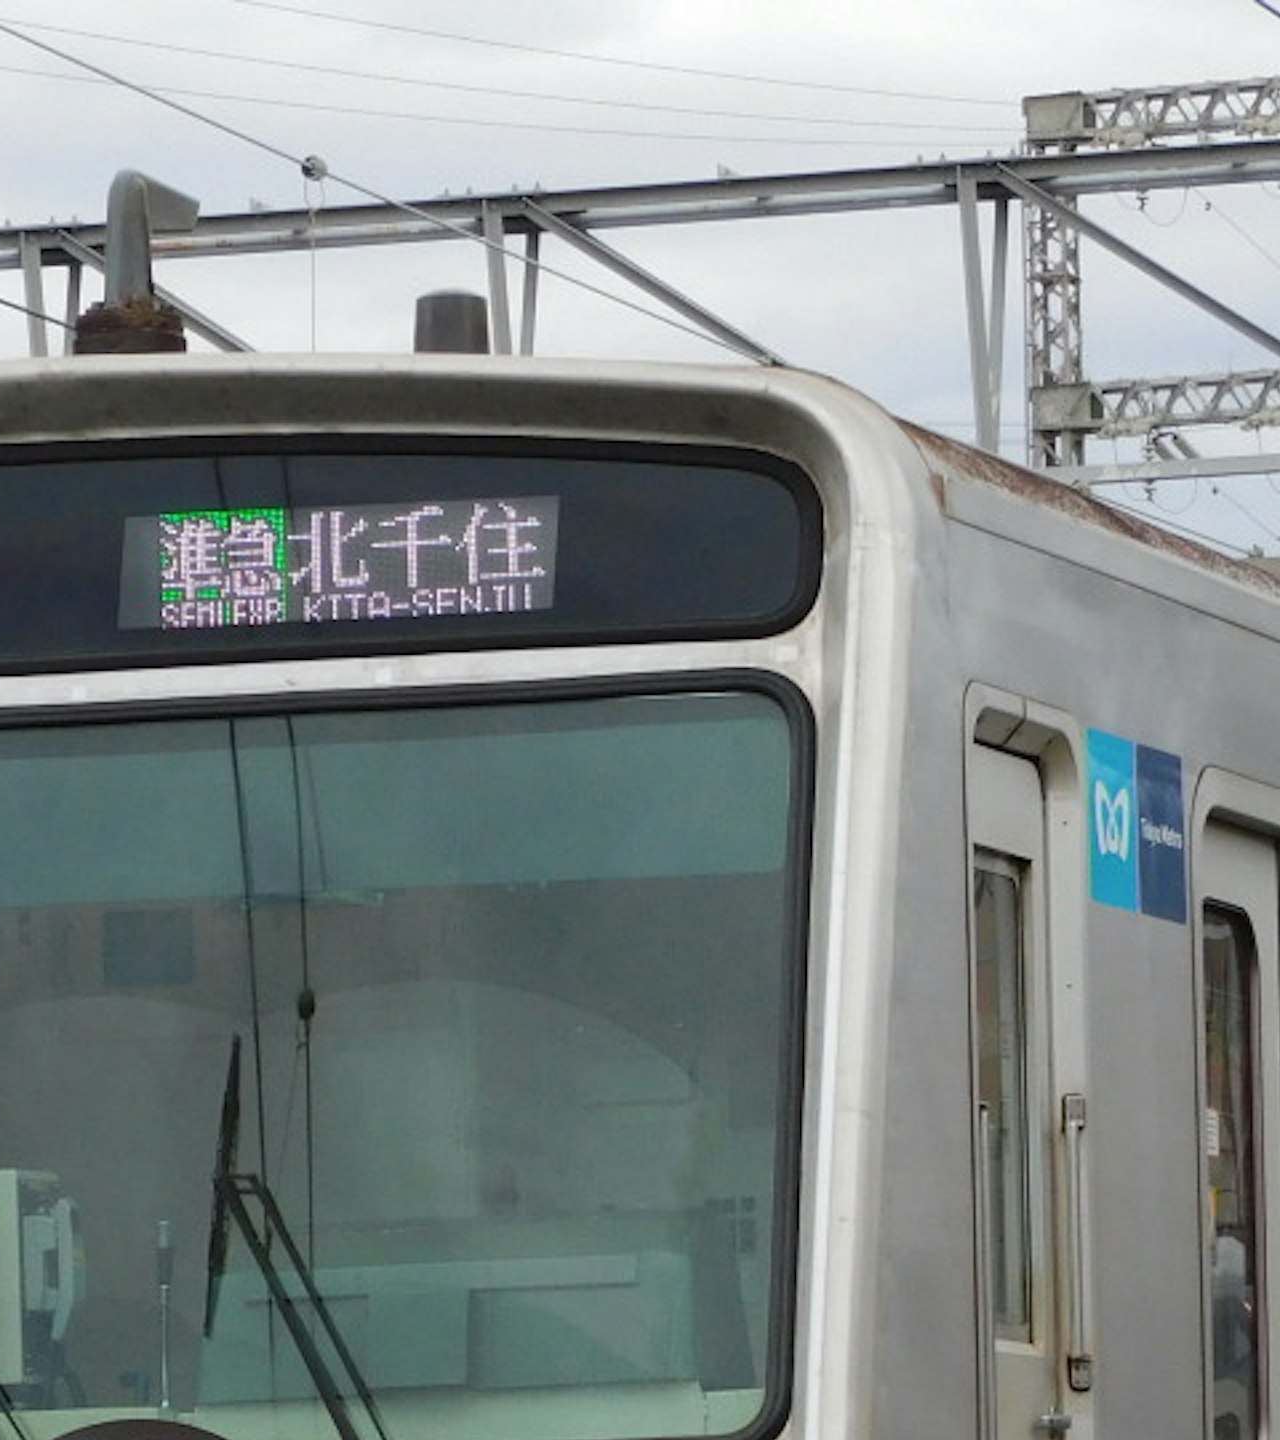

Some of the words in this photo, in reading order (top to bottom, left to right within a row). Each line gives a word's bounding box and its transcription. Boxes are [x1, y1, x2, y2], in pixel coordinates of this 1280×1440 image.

[160, 512, 282, 600] 準急
[287, 502, 546, 592] 北千住
